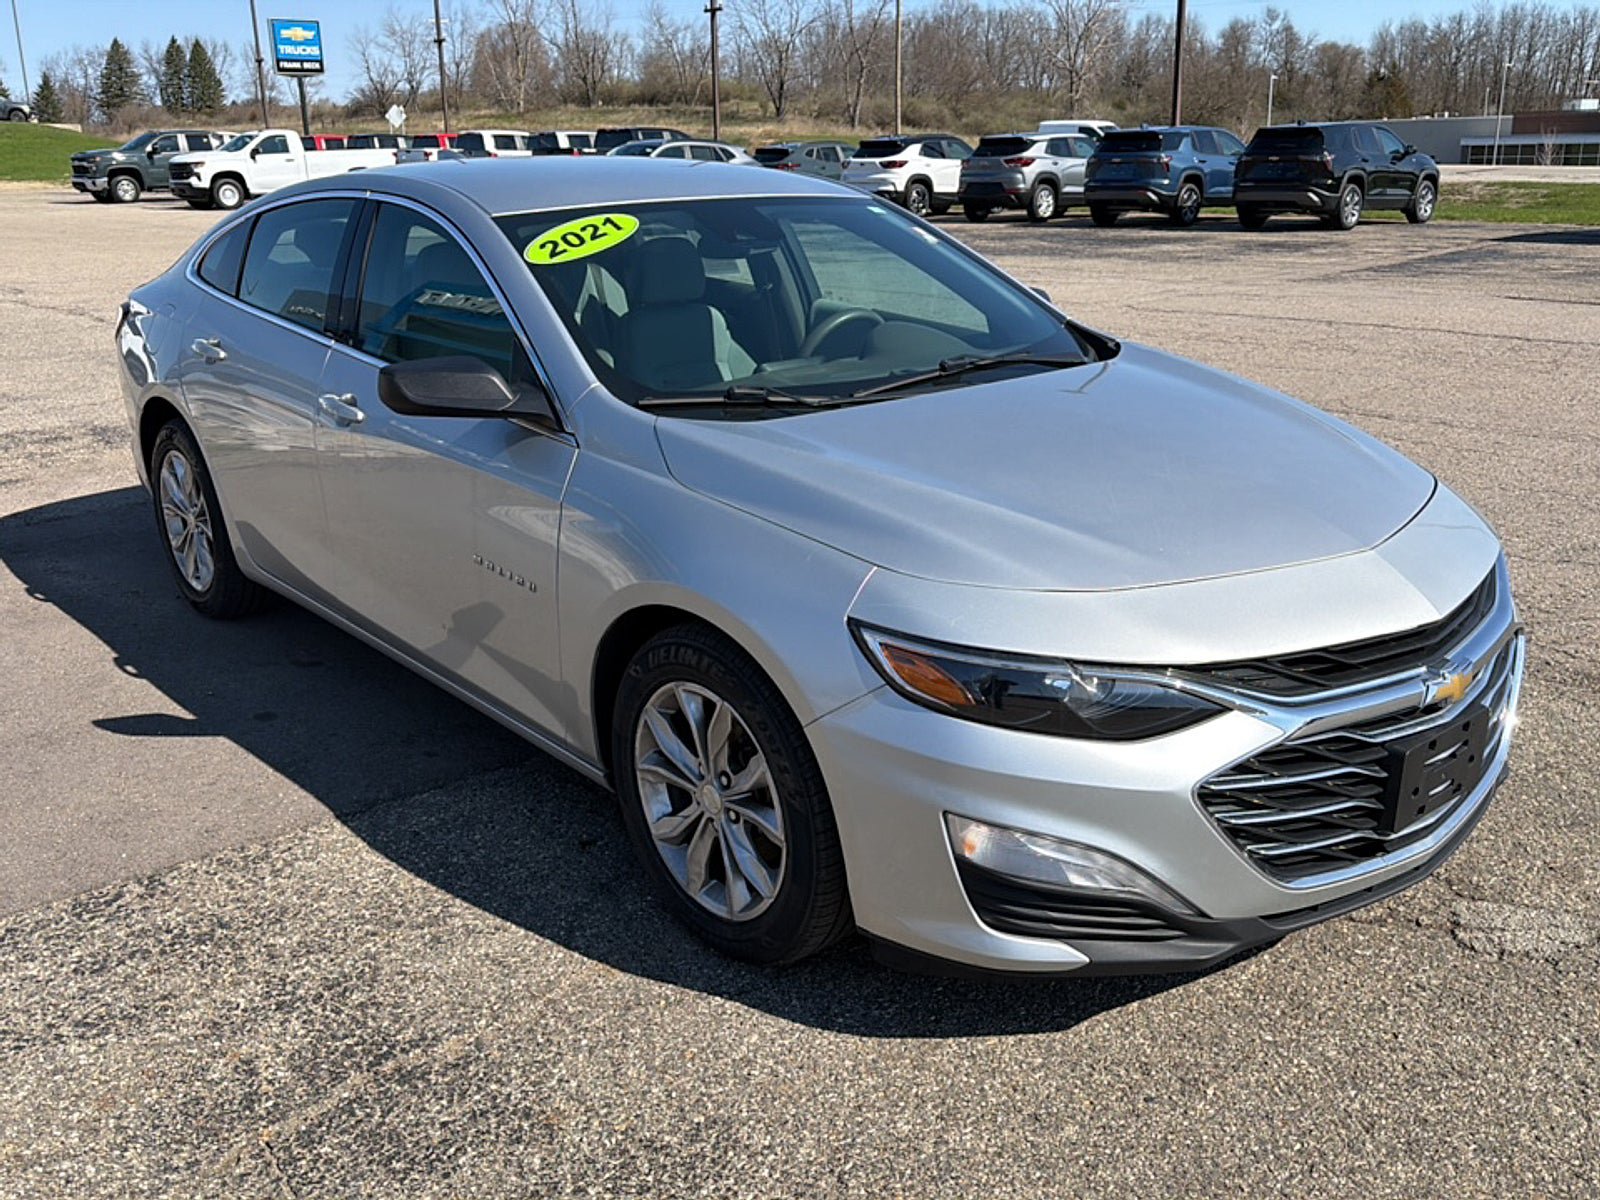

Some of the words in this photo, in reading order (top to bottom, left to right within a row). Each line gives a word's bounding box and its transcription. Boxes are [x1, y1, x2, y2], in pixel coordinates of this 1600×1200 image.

[277, 45, 319, 55] TRUCKS
[279, 61, 301, 69] FRANK
[303, 61, 320, 69] BECK
[539, 217, 623, 260] 2021
[471, 553, 538, 593] MALIBU
